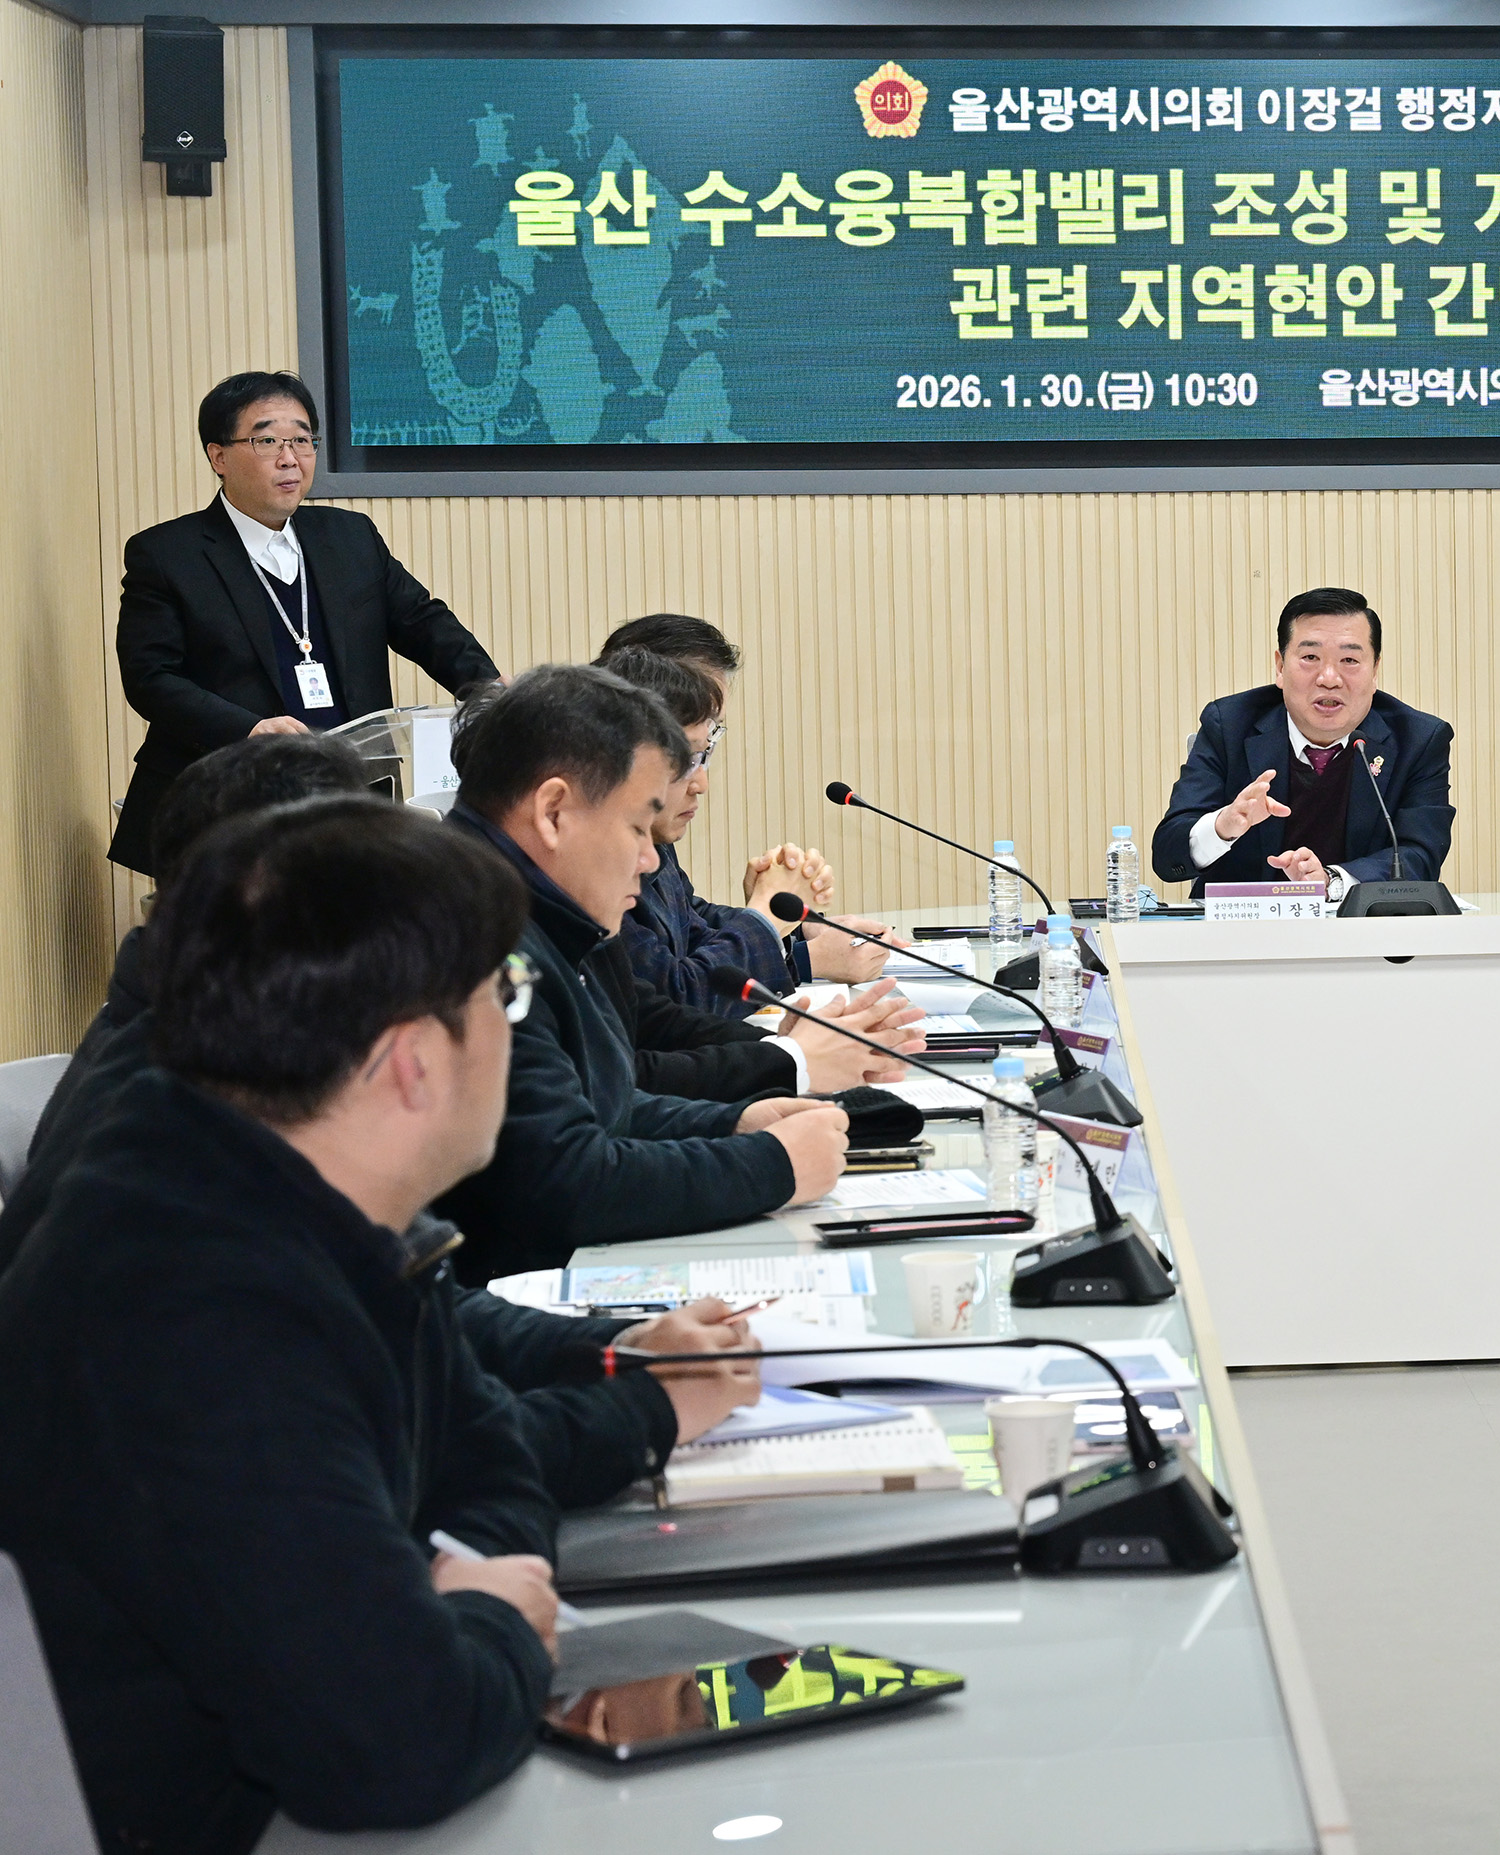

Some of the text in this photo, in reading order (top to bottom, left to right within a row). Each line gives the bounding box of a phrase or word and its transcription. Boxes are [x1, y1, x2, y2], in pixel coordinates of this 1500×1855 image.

[874, 91, 909, 111] 의회
[948, 86, 1243, 133] 울산광역시의회
[1257, 86, 1382, 132] 이장걸
[508, 169, 657, 246] 울산
[680, 168, 1184, 247] 수소융복합밸리
[1210, 168, 1348, 245] 조성
[1380, 168, 1445, 245] 및
[949, 264, 1089, 340] 관련
[1117, 263, 1404, 340] 지역현안
[896, 370, 1258, 411] 2026. 1. 30.(금) 10:30
